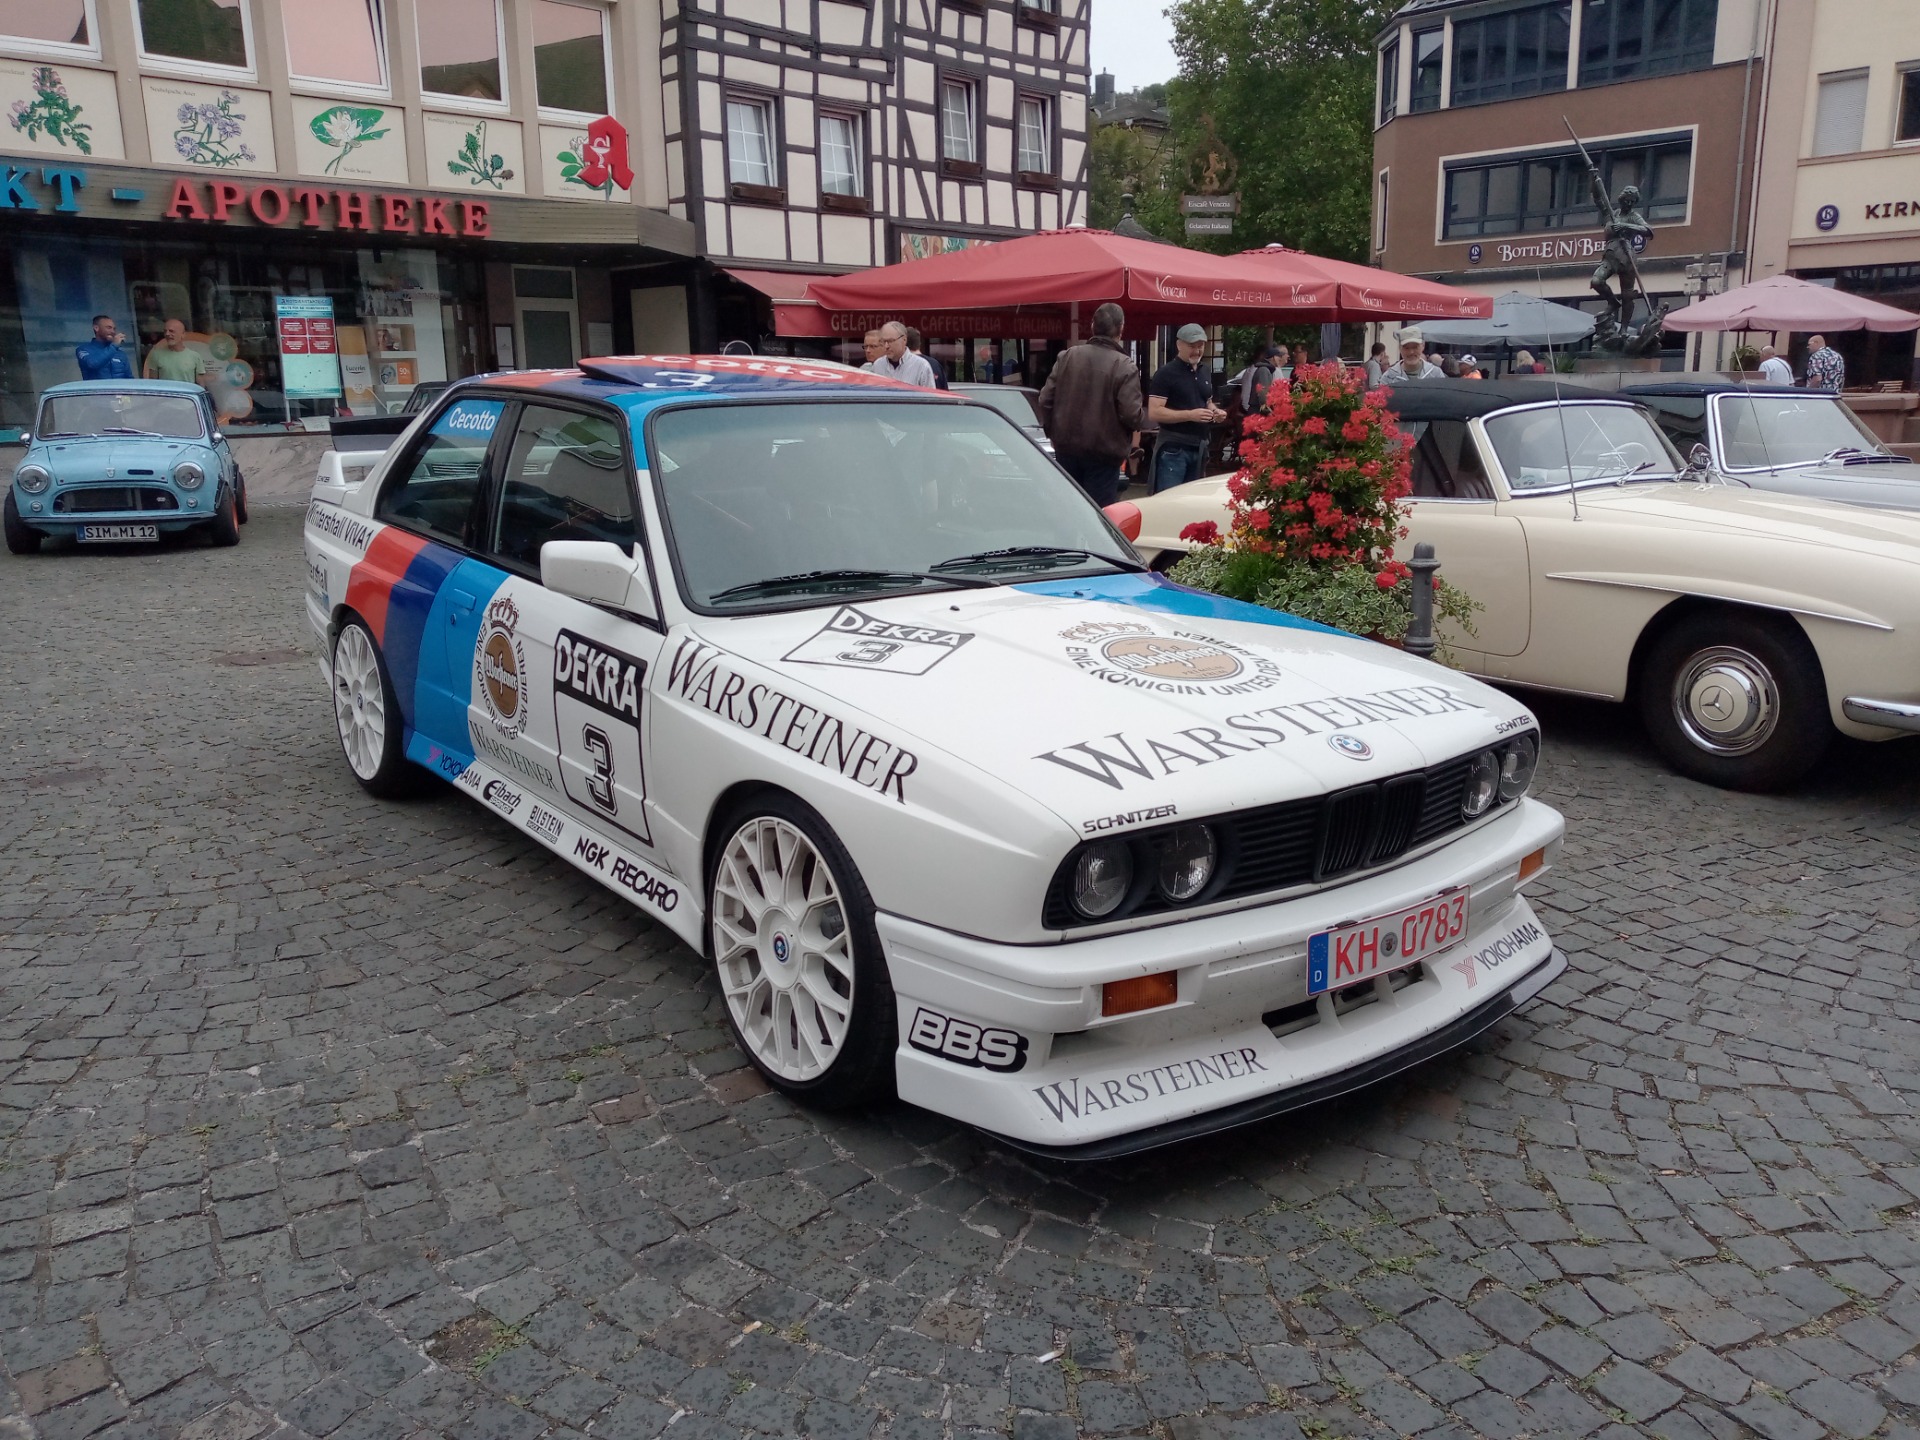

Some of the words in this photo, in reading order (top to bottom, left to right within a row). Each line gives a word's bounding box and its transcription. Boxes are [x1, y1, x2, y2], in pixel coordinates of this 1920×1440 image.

[164, 177, 492, 238] APOTHEKE
[1155, 275, 1187, 299] Venezia
[1212, 289, 1272, 303] GELATERIA
[1400, 299, 1445, 313] GELATERIA
[920, 315, 1001, 333] CAFFETTERIA
[1013, 317, 1063, 333] ITALIANA
[449, 407, 496, 431] Cecotto
[85, 527, 112, 538] SIM
[119, 527, 136, 537] MI
[138, 526, 155, 537] 12
[305, 502, 346, 541] Wintershall
[830, 607, 963, 646] DEKRA
[836, 639, 905, 665] 3
[1066, 646, 1101, 670] EINE
[1089, 667, 1207, 696] KÖNIGIN
[1210, 674, 1277, 696] UNTER
[475, 622, 488, 654] EINE
[495, 721, 519, 740] UNTER
[555, 634, 639, 718] DEKRA
[667, 635, 919, 806] WARSTEINER
[1030, 685, 1486, 791] WARSTEINER
[1494, 714, 1533, 735] SCHNITZER
[440, 753, 481, 790] YOKOHAMA
[469, 720, 560, 793] WARSTEINER
[582, 723, 618, 817] 3
[483, 779, 522, 808] Eibach
[529, 804, 565, 837] BILSTEIN
[1083, 804, 1178, 834] SCHNITZER
[573, 834, 610, 872] NGK
[610, 856, 679, 913] RECARO
[1314, 970, 1322, 983] D
[1335, 927, 1379, 979] KH
[1401, 895, 1465, 958] 0783
[1474, 921, 1544, 971] YOKOHAMA
[908, 1007, 1029, 1072] BBS
[1032, 1047, 1270, 1124] WARSTEINER
